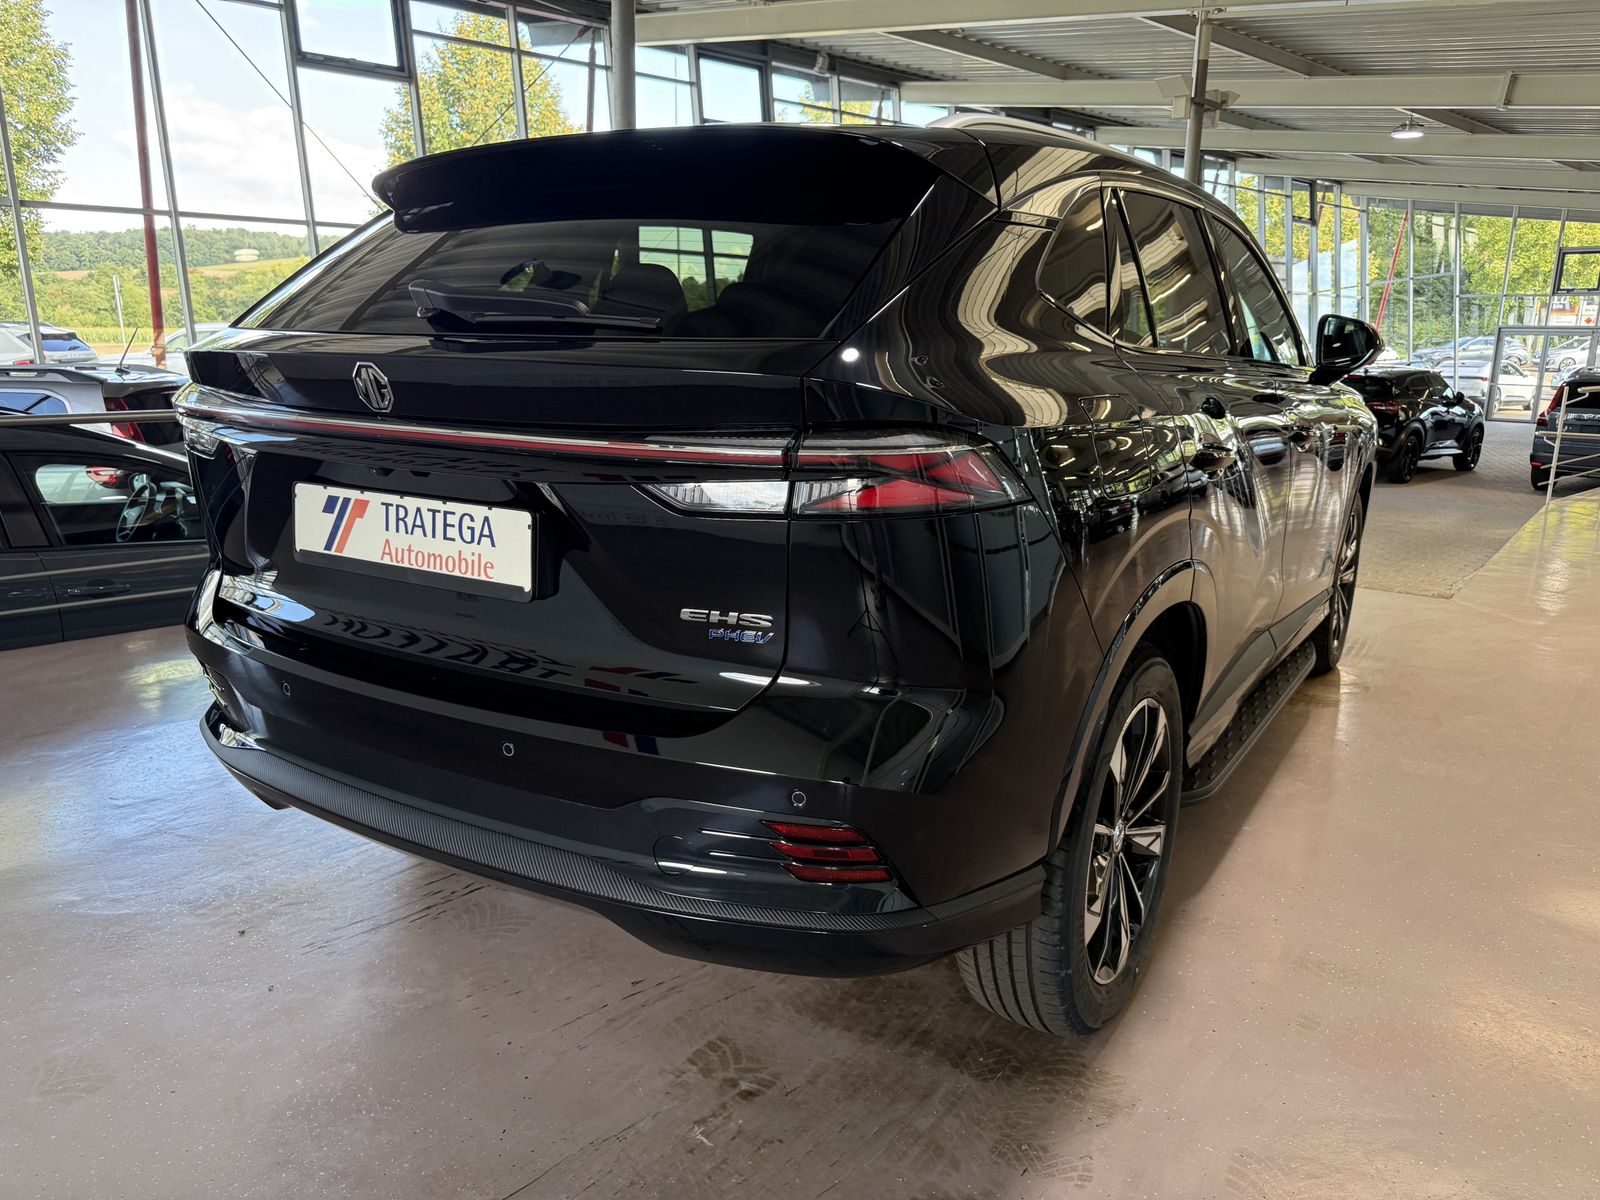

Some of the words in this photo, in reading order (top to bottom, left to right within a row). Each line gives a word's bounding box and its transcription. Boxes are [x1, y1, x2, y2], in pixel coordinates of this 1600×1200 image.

[355, 366, 391, 409] MG
[380, 501, 497, 549] TRATEGA
[380, 538, 496, 580] Automobile
[680, 608, 774, 628] EHS
[708, 628, 775, 644] PHEV
